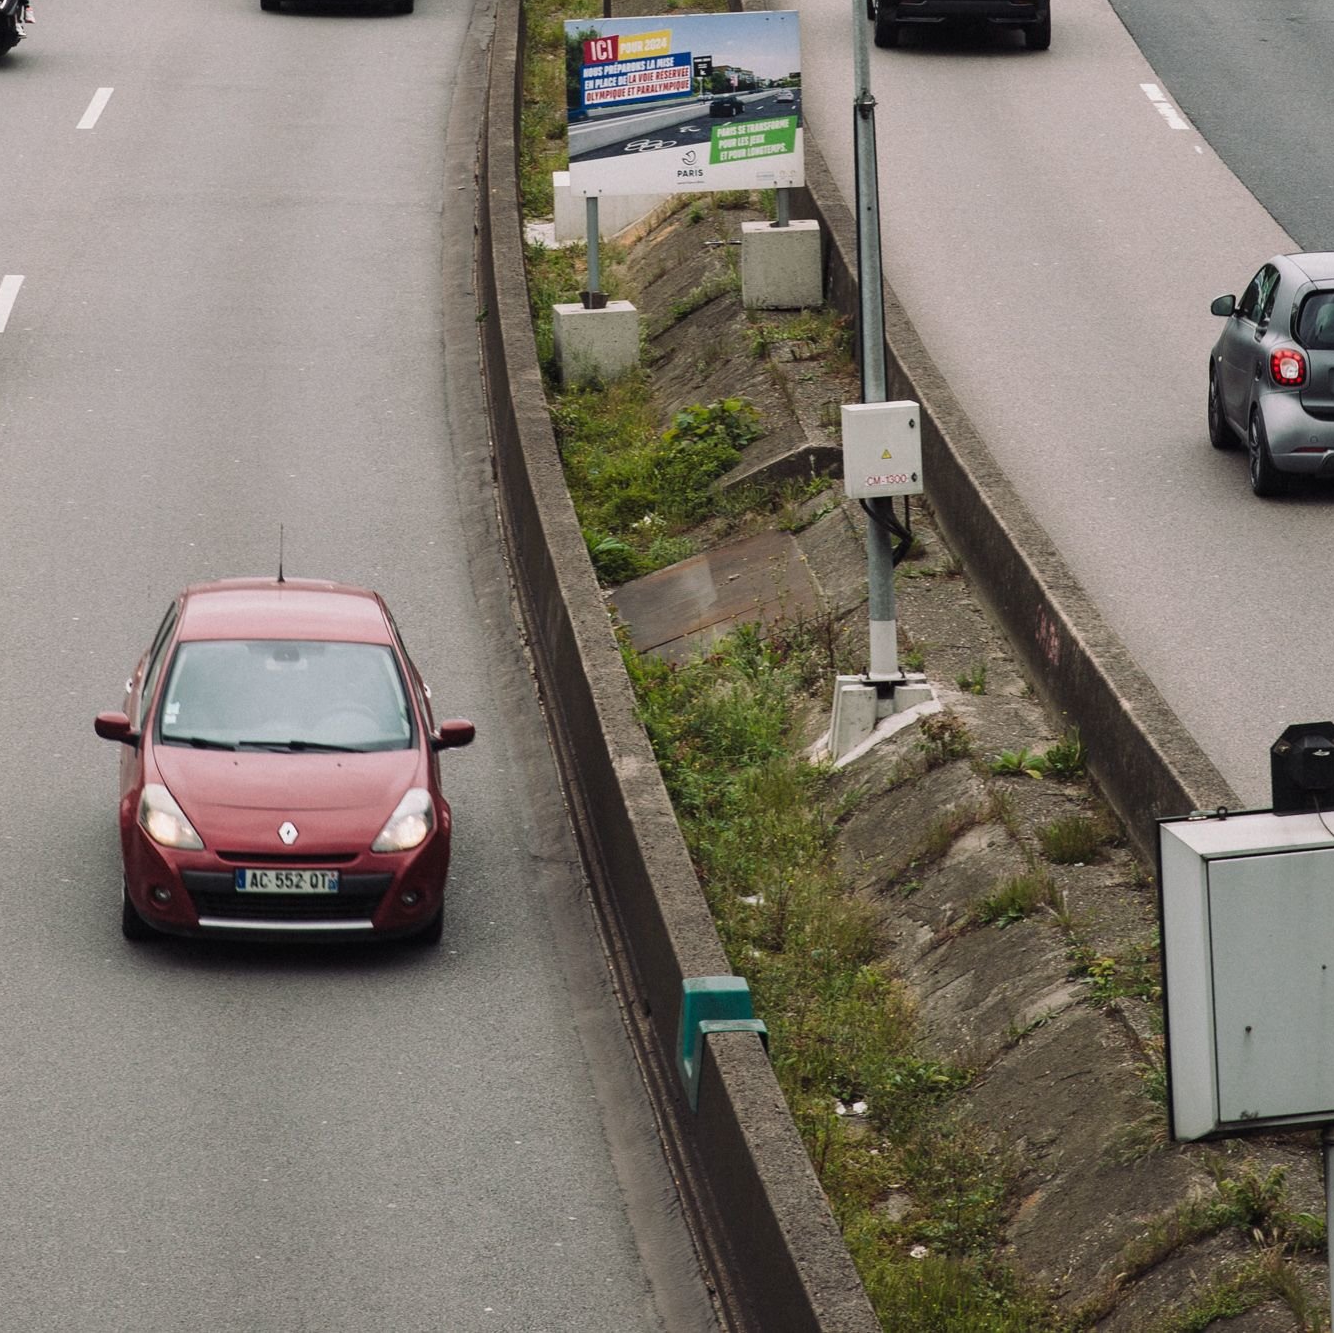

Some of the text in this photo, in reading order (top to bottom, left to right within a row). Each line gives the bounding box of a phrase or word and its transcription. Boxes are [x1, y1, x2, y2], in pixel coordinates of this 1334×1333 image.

[591, 37, 667, 61] ICI POUR 2024
[583, 66, 603, 78] NOUS
[647, 60, 656, 69] LA
[656, 57, 674, 68] MISE
[585, 80, 594, 90] EN
[595, 77, 617, 88] PLACE
[619, 75, 628, 85] DE
[628, 74, 637, 84] LA
[638, 71, 654, 82] VOIE
[586, 79, 690, 102] OLYMPIQUE ET PARALYMPIQUE
[717, 119, 789, 138] PARIS SE TRANSFORME
[718, 134, 765, 149] POUR LES JEUX
[720, 142, 788, 161] ET POUR LONGTEMPS.
[677, 169, 703, 177] PARIS
[867, 474, 907, 486] CM-1300
